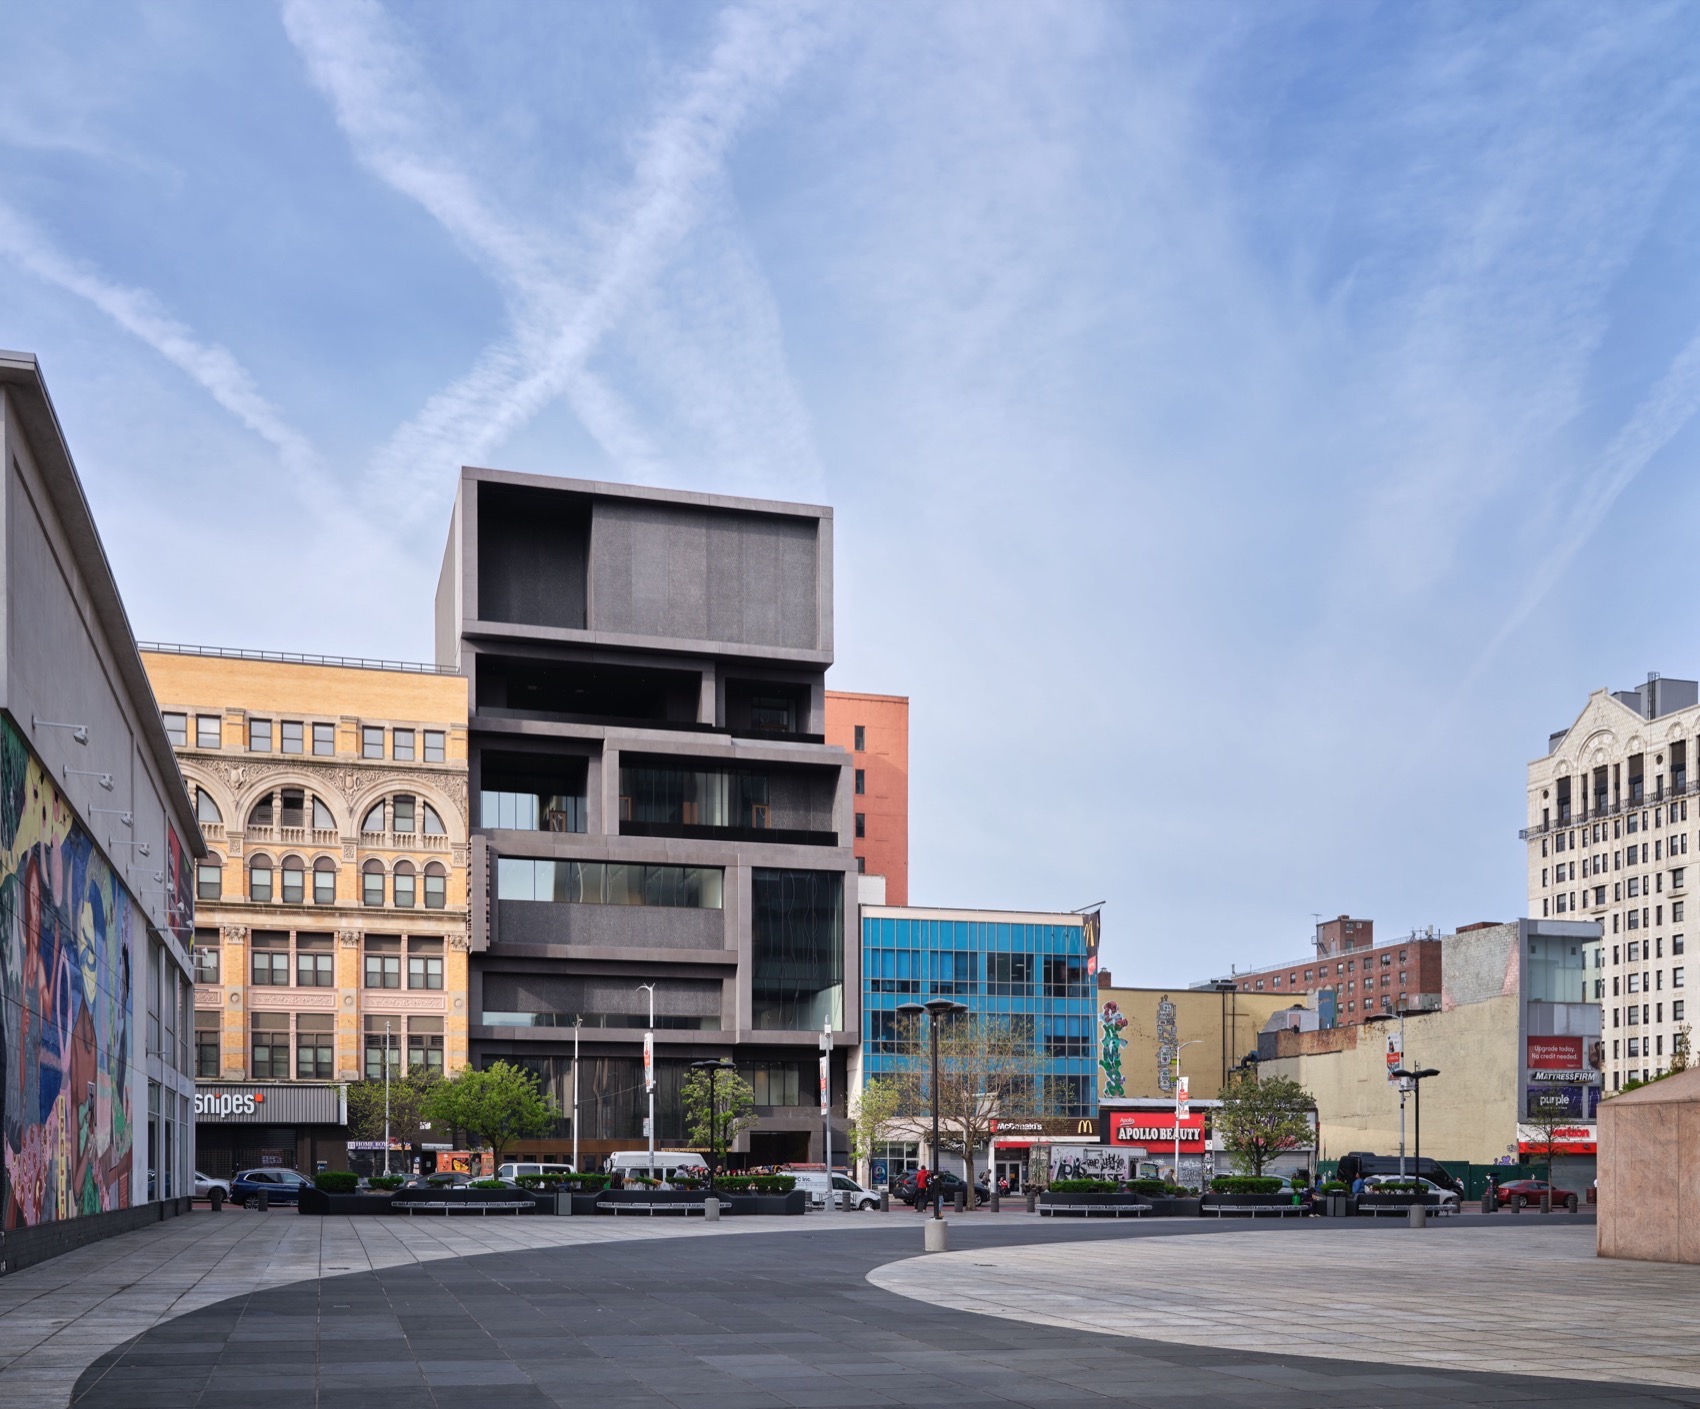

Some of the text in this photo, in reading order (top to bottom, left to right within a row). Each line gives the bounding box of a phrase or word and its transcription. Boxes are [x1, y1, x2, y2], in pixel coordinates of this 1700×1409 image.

[1559, 1045, 1576, 1053] today.
[194, 1093, 255, 1118] snipes
[1540, 1094, 1570, 1106] purple
[1118, 1127, 1201, 1141] APOLLO BEAUTY
